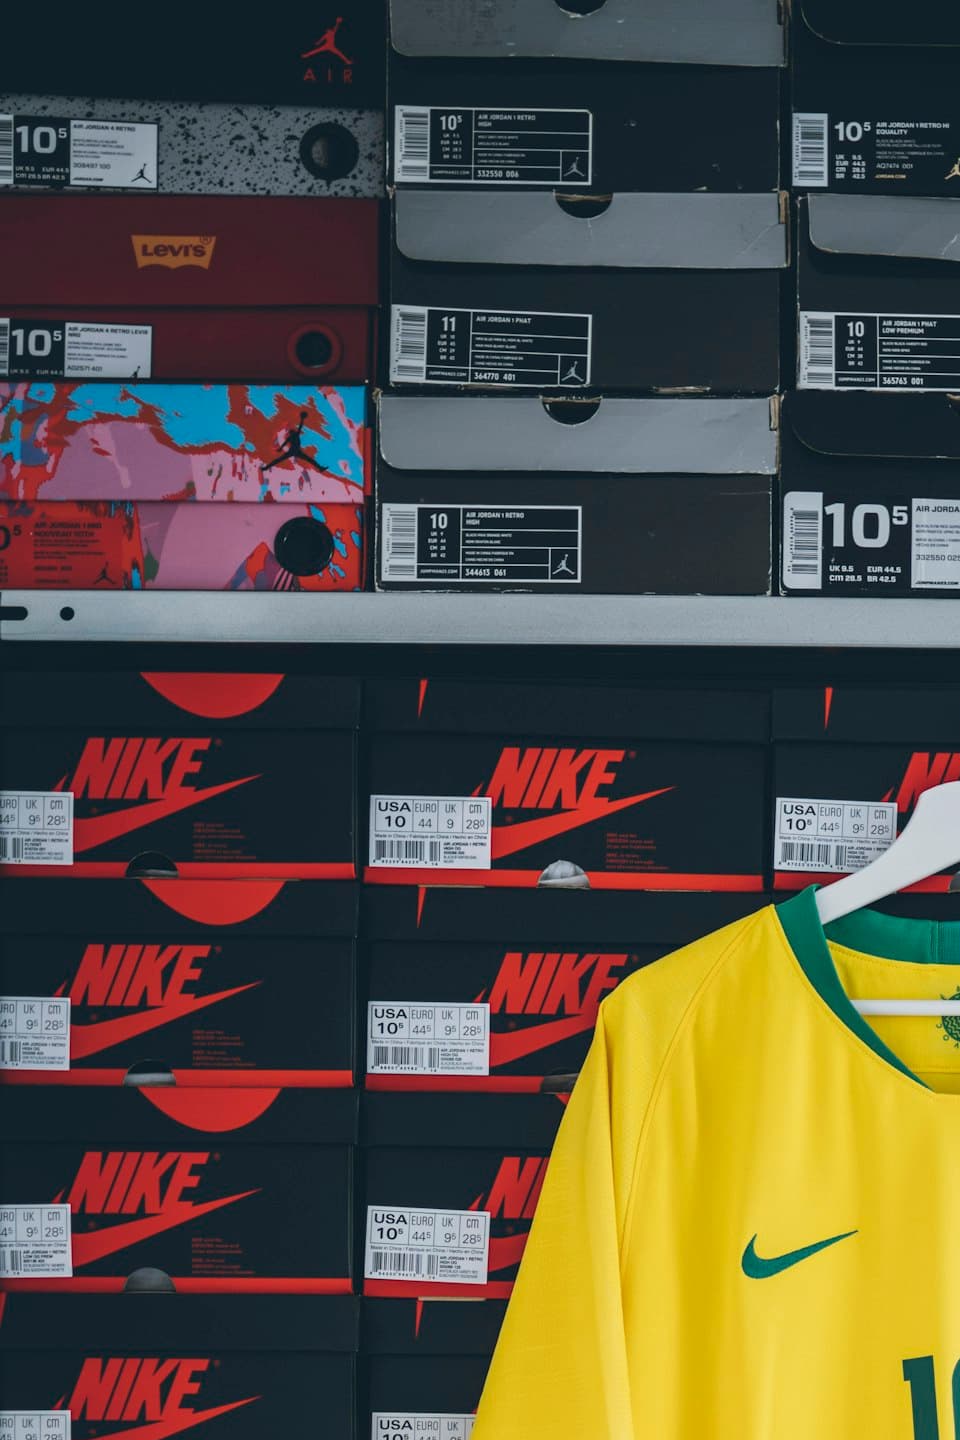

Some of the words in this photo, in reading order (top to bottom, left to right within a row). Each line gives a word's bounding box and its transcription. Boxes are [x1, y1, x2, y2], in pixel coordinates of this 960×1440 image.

[303, 68, 353, 83] AIR
[477, 170, 503, 178] 332550
[506, 170, 519, 178] 006
[441, 316, 456, 332] 11
[487, 316, 510, 324] JORDAN
[847, 321, 865, 337] 10
[896, 327, 925, 335] PREMIUM
[474, 372, 500, 381] 364770
[503, 373, 516, 381] 401
[916, 505, 930, 513] AIR
[429, 513, 448, 529] 10
[915, 554, 946, 562] 332550
[465, 568, 490, 577] 344613
[494, 568, 507, 577] 061
[70, 737, 212, 800] NIKE
[485, 747, 625, 810] NIKE
[378, 801, 411, 813] USA
[414, 803, 437, 813] EURO
[445, 804, 457, 814] UK
[384, 816, 406, 828] 10
[69, 944, 212, 1007] NIKE
[488, 952, 628, 1015] NIKE
[67, 1151, 210, 1214] NIKE
[374, 1213, 407, 1225] USA
[71, 1358, 210, 1420] NIKE
[378, 1418, 413, 1431] USA
